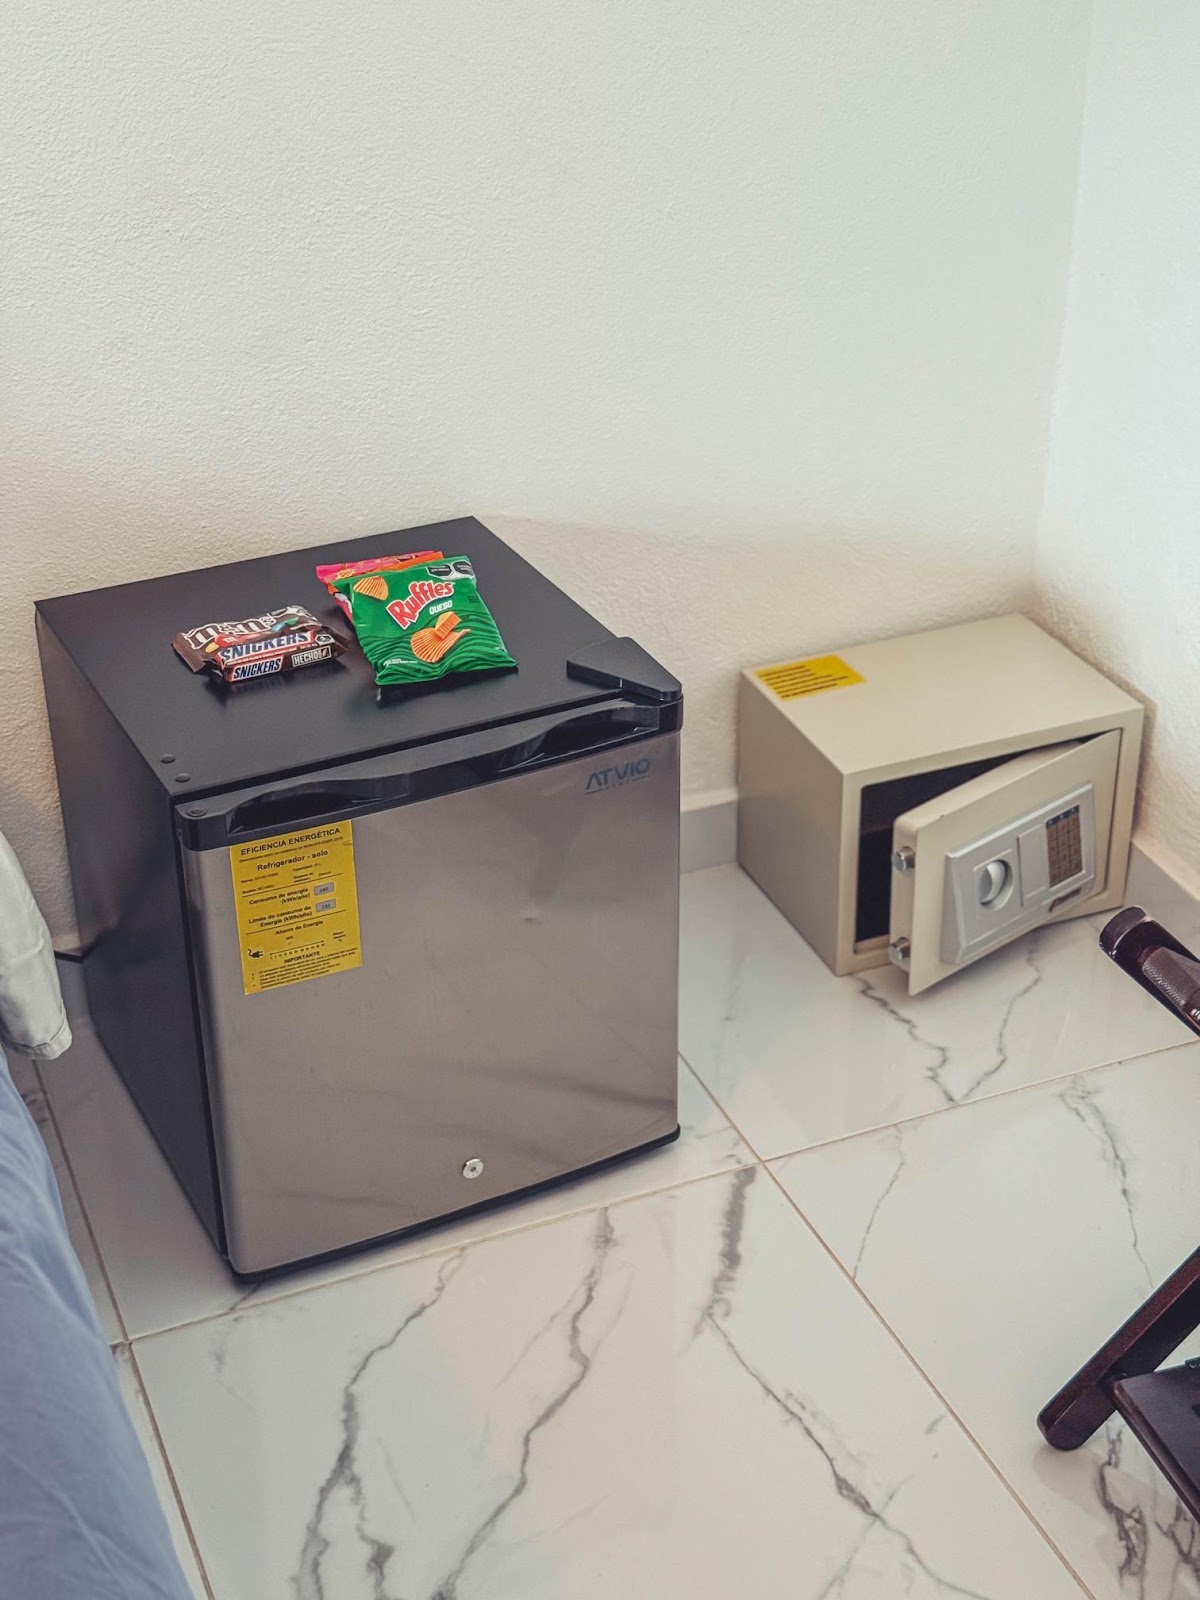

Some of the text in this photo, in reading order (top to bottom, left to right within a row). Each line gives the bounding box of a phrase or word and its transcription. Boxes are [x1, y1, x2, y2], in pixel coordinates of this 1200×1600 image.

[387, 580, 454, 630] Ruffles
[429, 600, 453, 616] QUESO
[220, 632, 309, 661] SNICKERS
[234, 660, 282, 679] SNICKERS
[585, 758, 651, 790] ATVIO
[241, 840, 287, 856] EFICIENCIA
[289, 827, 341, 845] ENERGÉTICA
[257, 855, 305, 871] Refrigerador
[312, 850, 328, 859] solo
[249, 896, 277, 905] Consumo
[284, 951, 320, 963] IMPORTANTE
